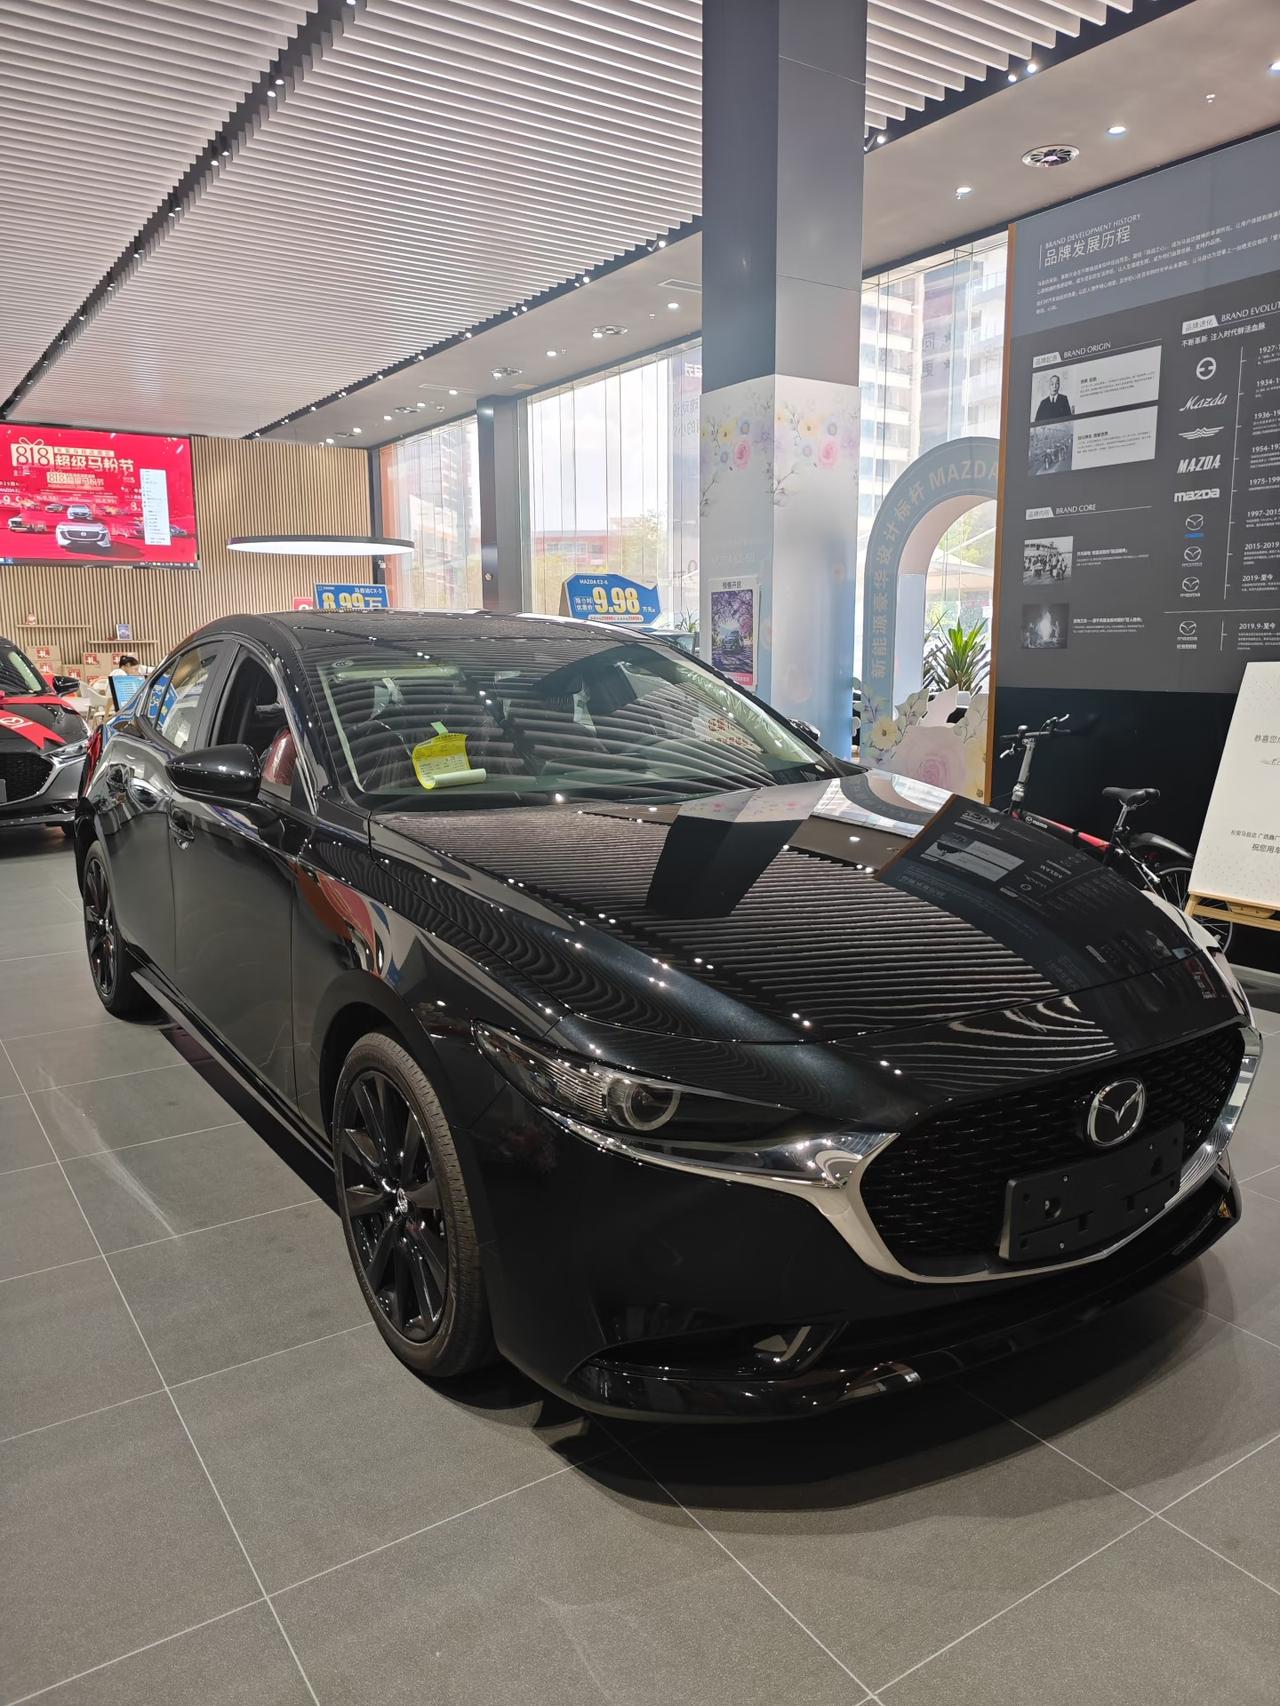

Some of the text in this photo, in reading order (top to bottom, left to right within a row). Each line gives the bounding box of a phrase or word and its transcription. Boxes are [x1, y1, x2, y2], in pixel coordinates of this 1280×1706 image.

[1045, 214, 1141, 249] BRAND DEVELOPMENT HISTORY
[1044, 225, 1131, 267] 品牌发展历程
[1221, 309, 1249, 322] BRAND
[1063, 341, 1112, 359] BRAND ORIGIN
[1179, 392, 1228, 412] Mazda
[55, 454, 134, 473] 超级马粉节
[1177, 454, 1221, 474] MAZDA
[1056, 503, 1097, 515] BRAND CORE
[1244, 541, 1280, 550] 2015-2019
[592, 587, 640, 614] 9.98
